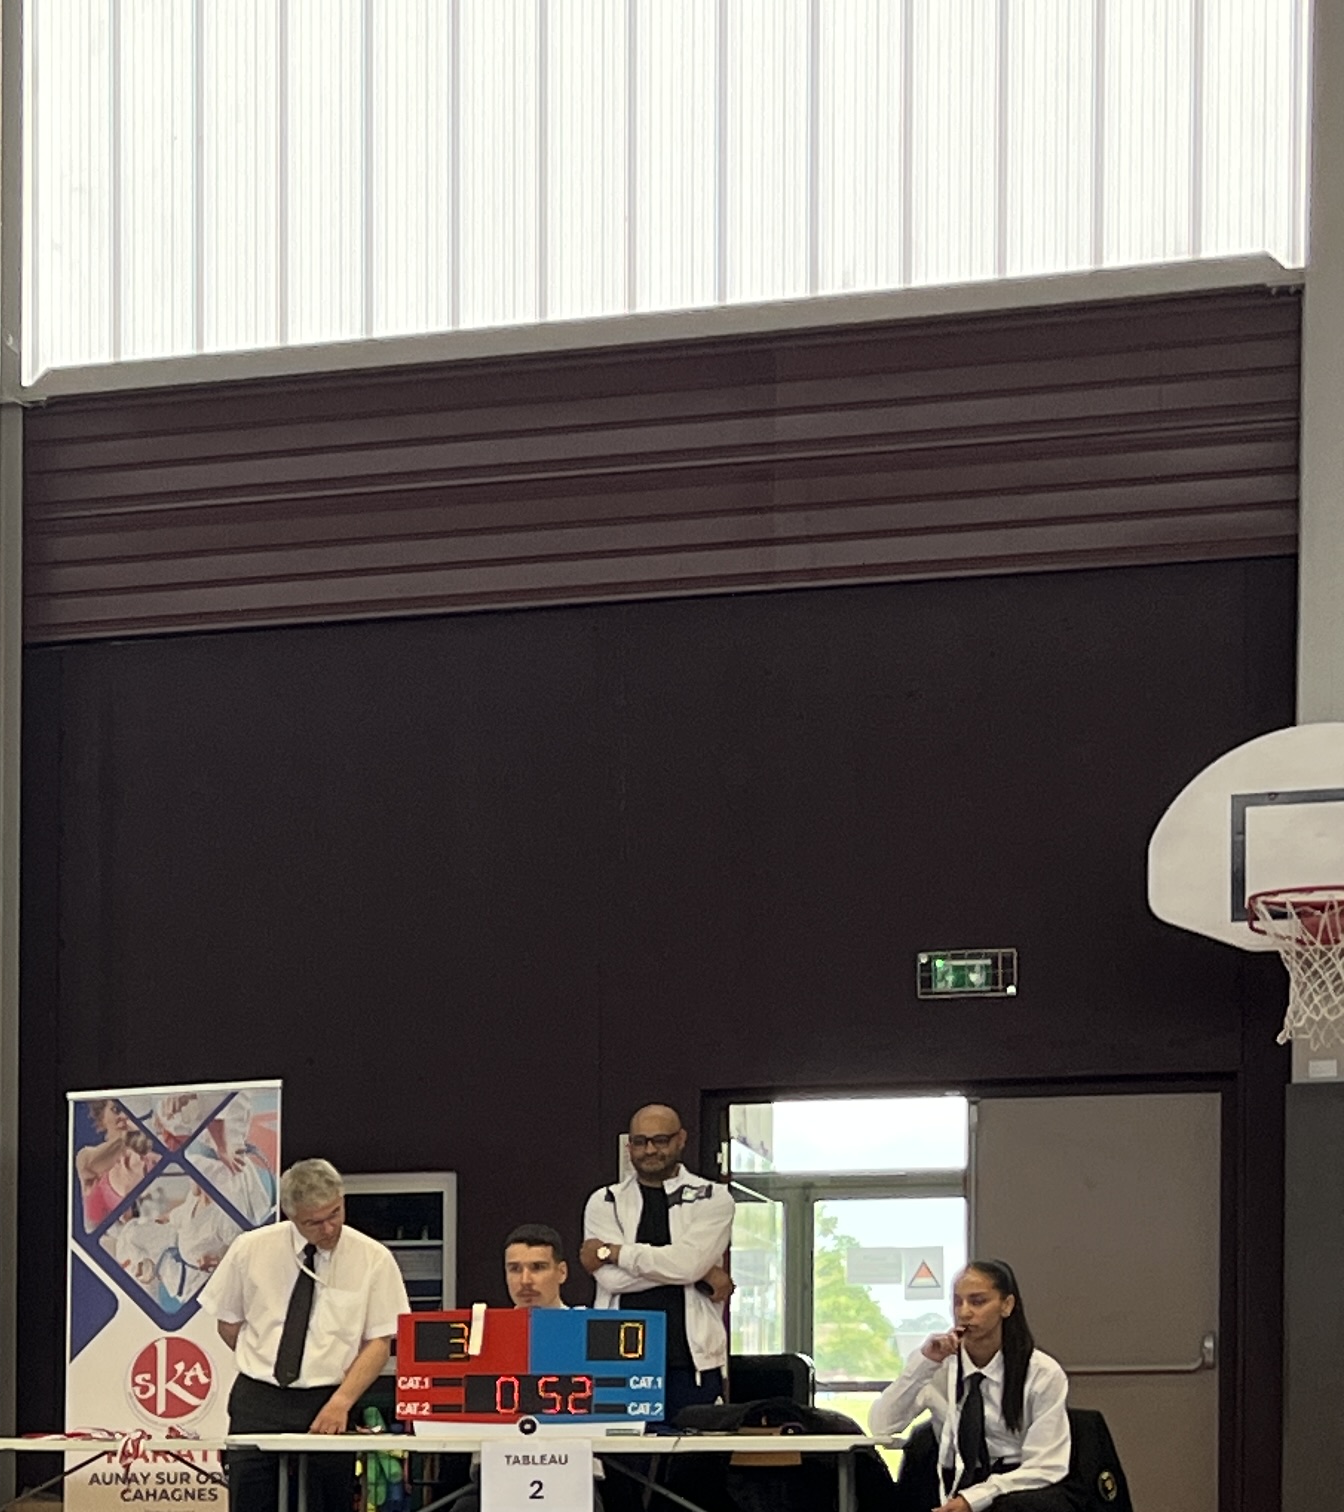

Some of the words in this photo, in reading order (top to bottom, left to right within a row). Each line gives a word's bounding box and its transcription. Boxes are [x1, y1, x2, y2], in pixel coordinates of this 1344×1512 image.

[620, 1322, 643, 1358] 0
[398, 1376, 431, 1390] CAT.1
[496, 1376, 519, 1414] 0
[538, 1376, 592, 1415] 52
[629, 1376, 663, 1389] CAT.1
[396, 1402, 430, 1415] CAT.2
[504, 1454, 568, 1465] TABLEAU
[88, 1472, 151, 1485] AUNAY
[155, 1472, 191, 1485] SUR
[120, 1488, 218, 1502] CAHAGNES
[529, 1480, 545, 1500] 2
